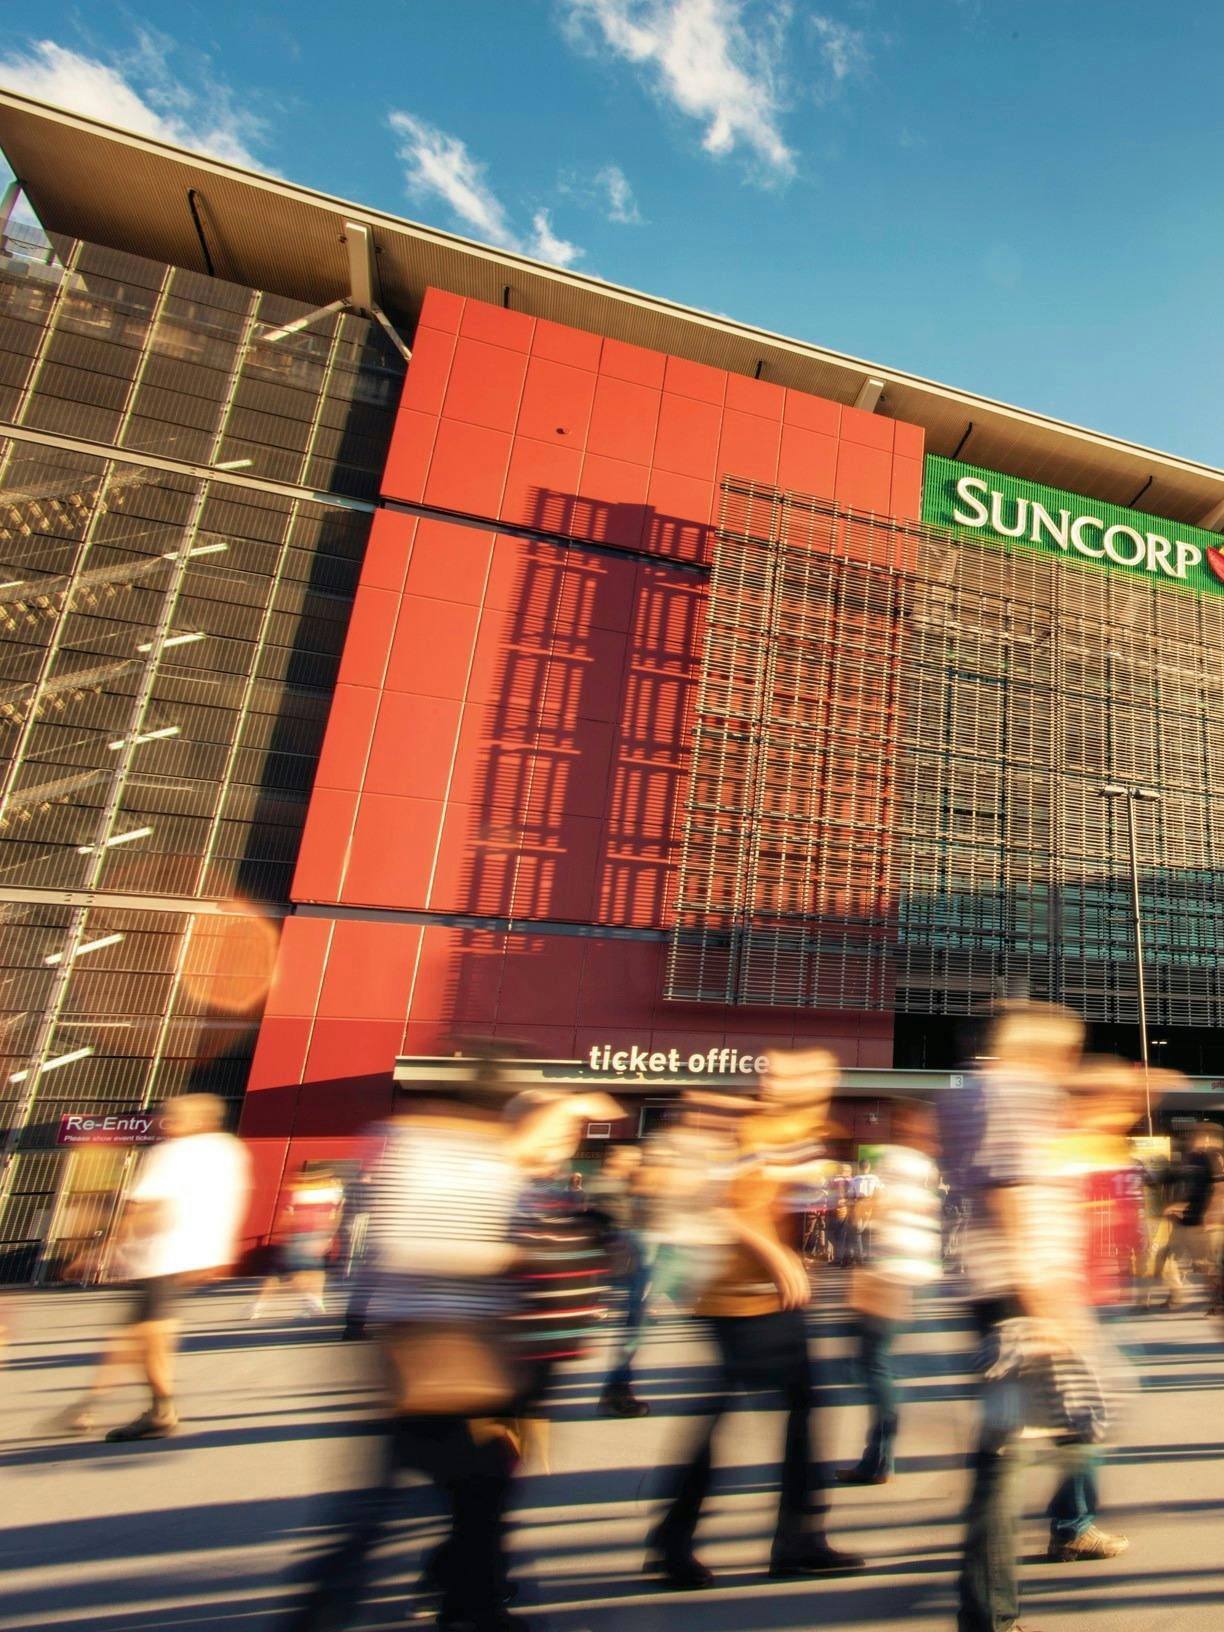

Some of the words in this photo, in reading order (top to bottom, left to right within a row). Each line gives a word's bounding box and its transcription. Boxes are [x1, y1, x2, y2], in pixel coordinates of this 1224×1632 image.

[953, 476, 1202, 579] SUNCORP
[589, 1045, 680, 1072] ticket
[688, 1048, 770, 1073] office
[66, 1116, 153, 1133] Re-Entry
